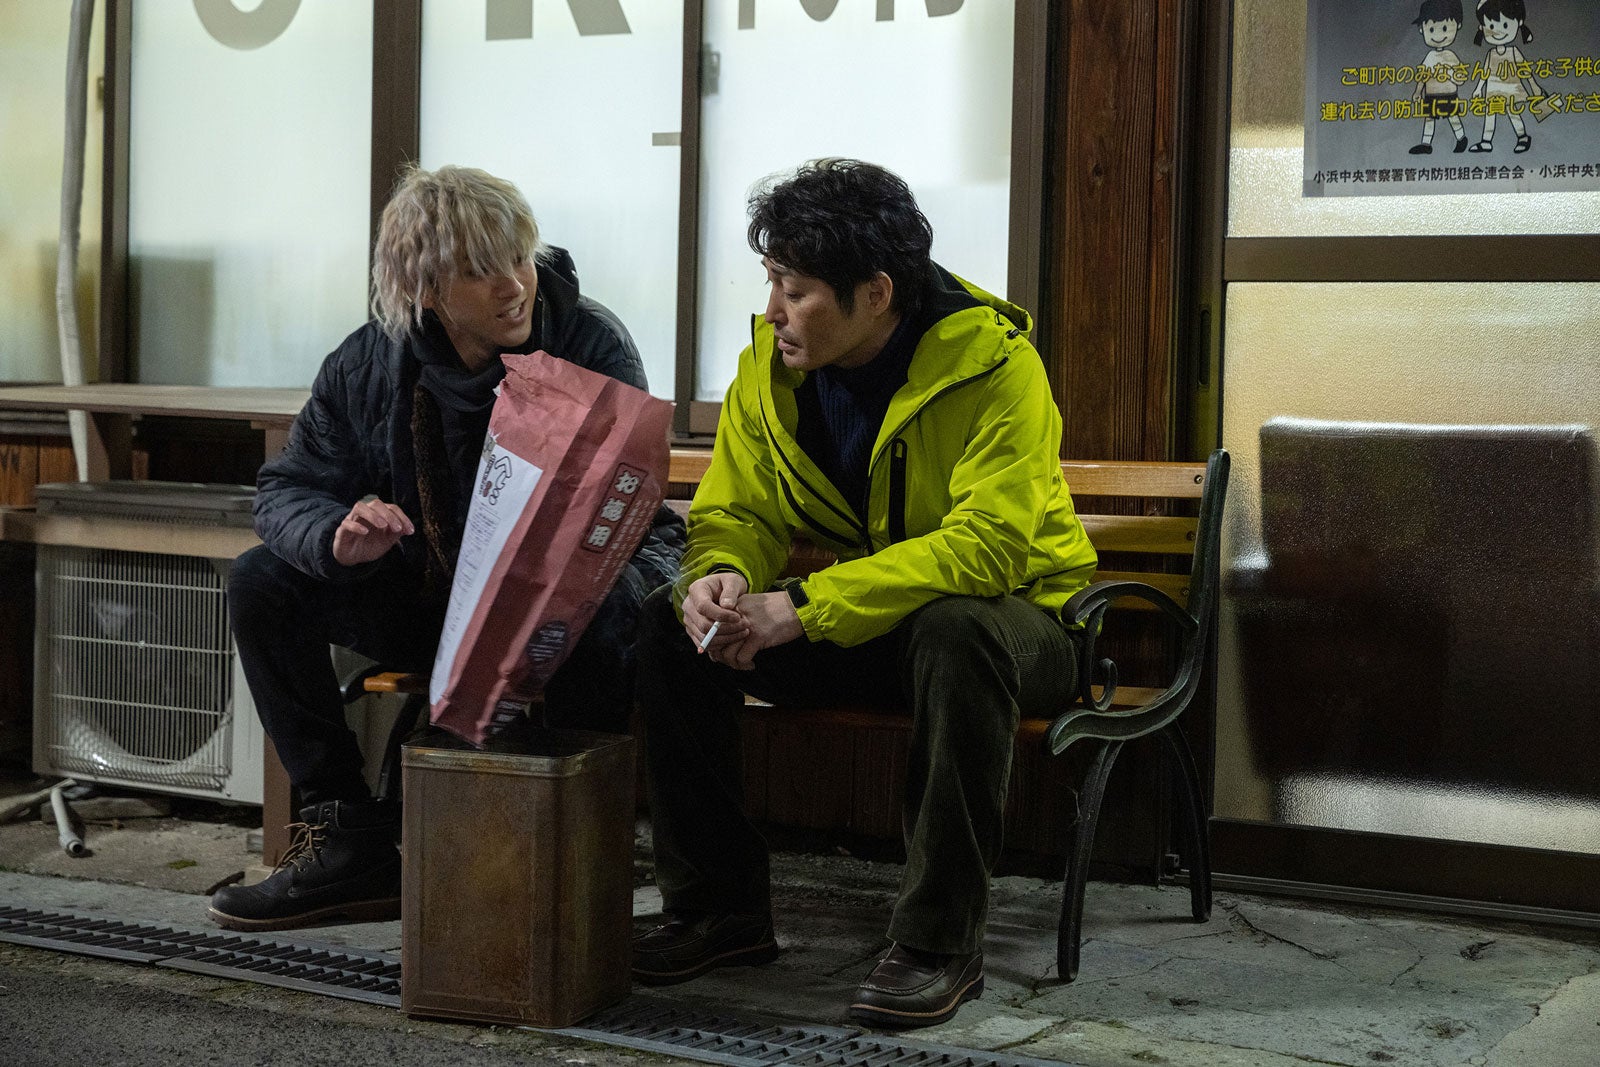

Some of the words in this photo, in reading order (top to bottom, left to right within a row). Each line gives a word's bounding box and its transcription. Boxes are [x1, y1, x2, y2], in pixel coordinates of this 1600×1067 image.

[1341, 61, 1491, 86] ご町内のみなさん
